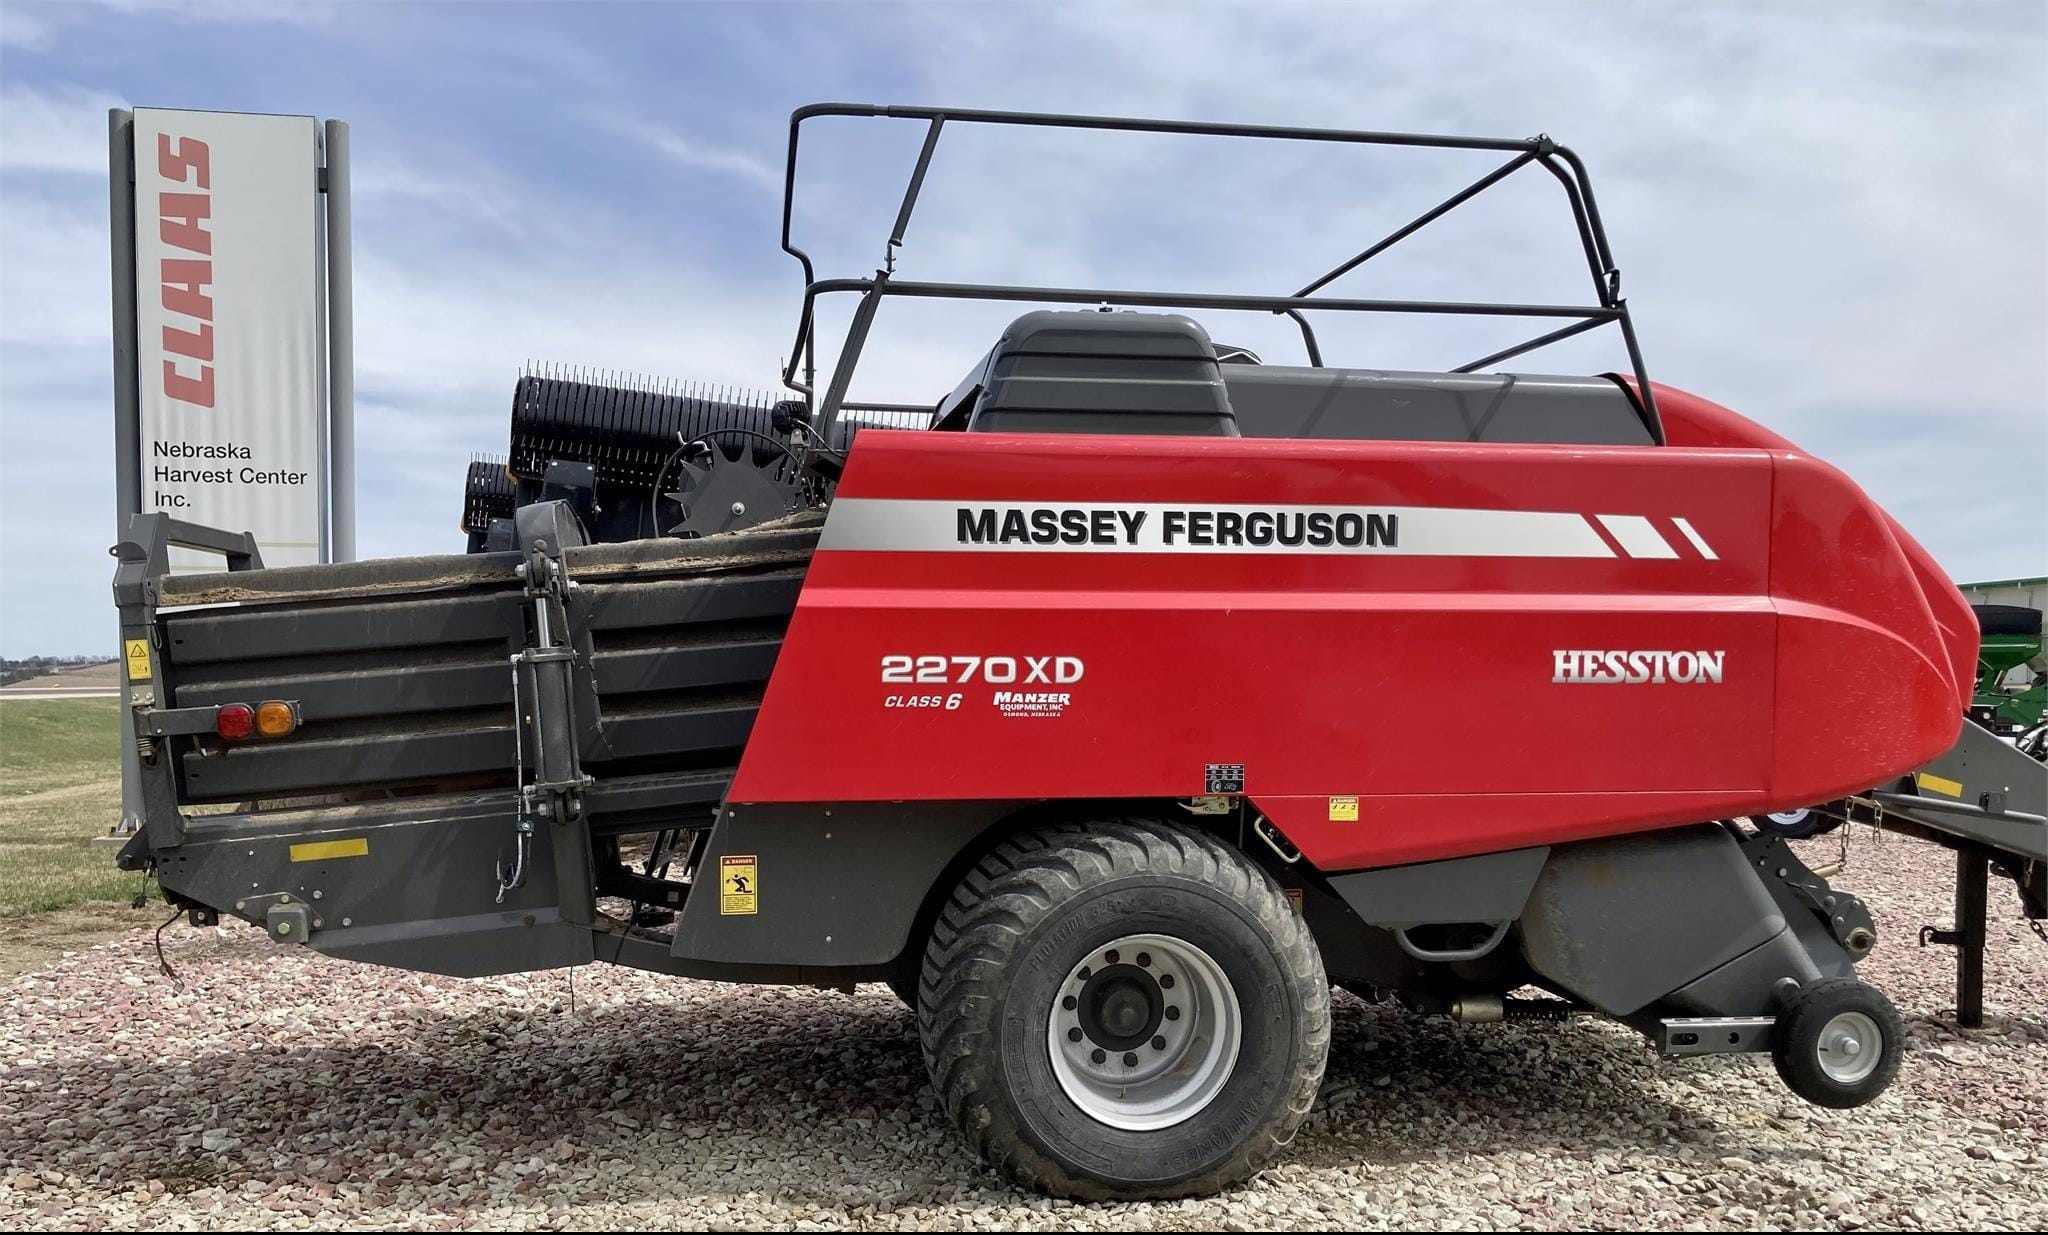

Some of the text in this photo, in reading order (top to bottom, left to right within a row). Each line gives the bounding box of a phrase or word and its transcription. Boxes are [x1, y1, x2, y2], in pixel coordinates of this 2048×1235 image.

[157, 132, 215, 409] CLAAS
[153, 440, 252, 460] Nebraska
[154, 465, 308, 485] Harvest Center
[154, 490, 191, 508] Inc.
[957, 507, 1399, 547] MASSEY FERGUSON
[1551, 649, 1726, 685] HESSTON
[884, 692, 964, 711] CLASS 6
[992, 691, 1072, 706] MANZER
